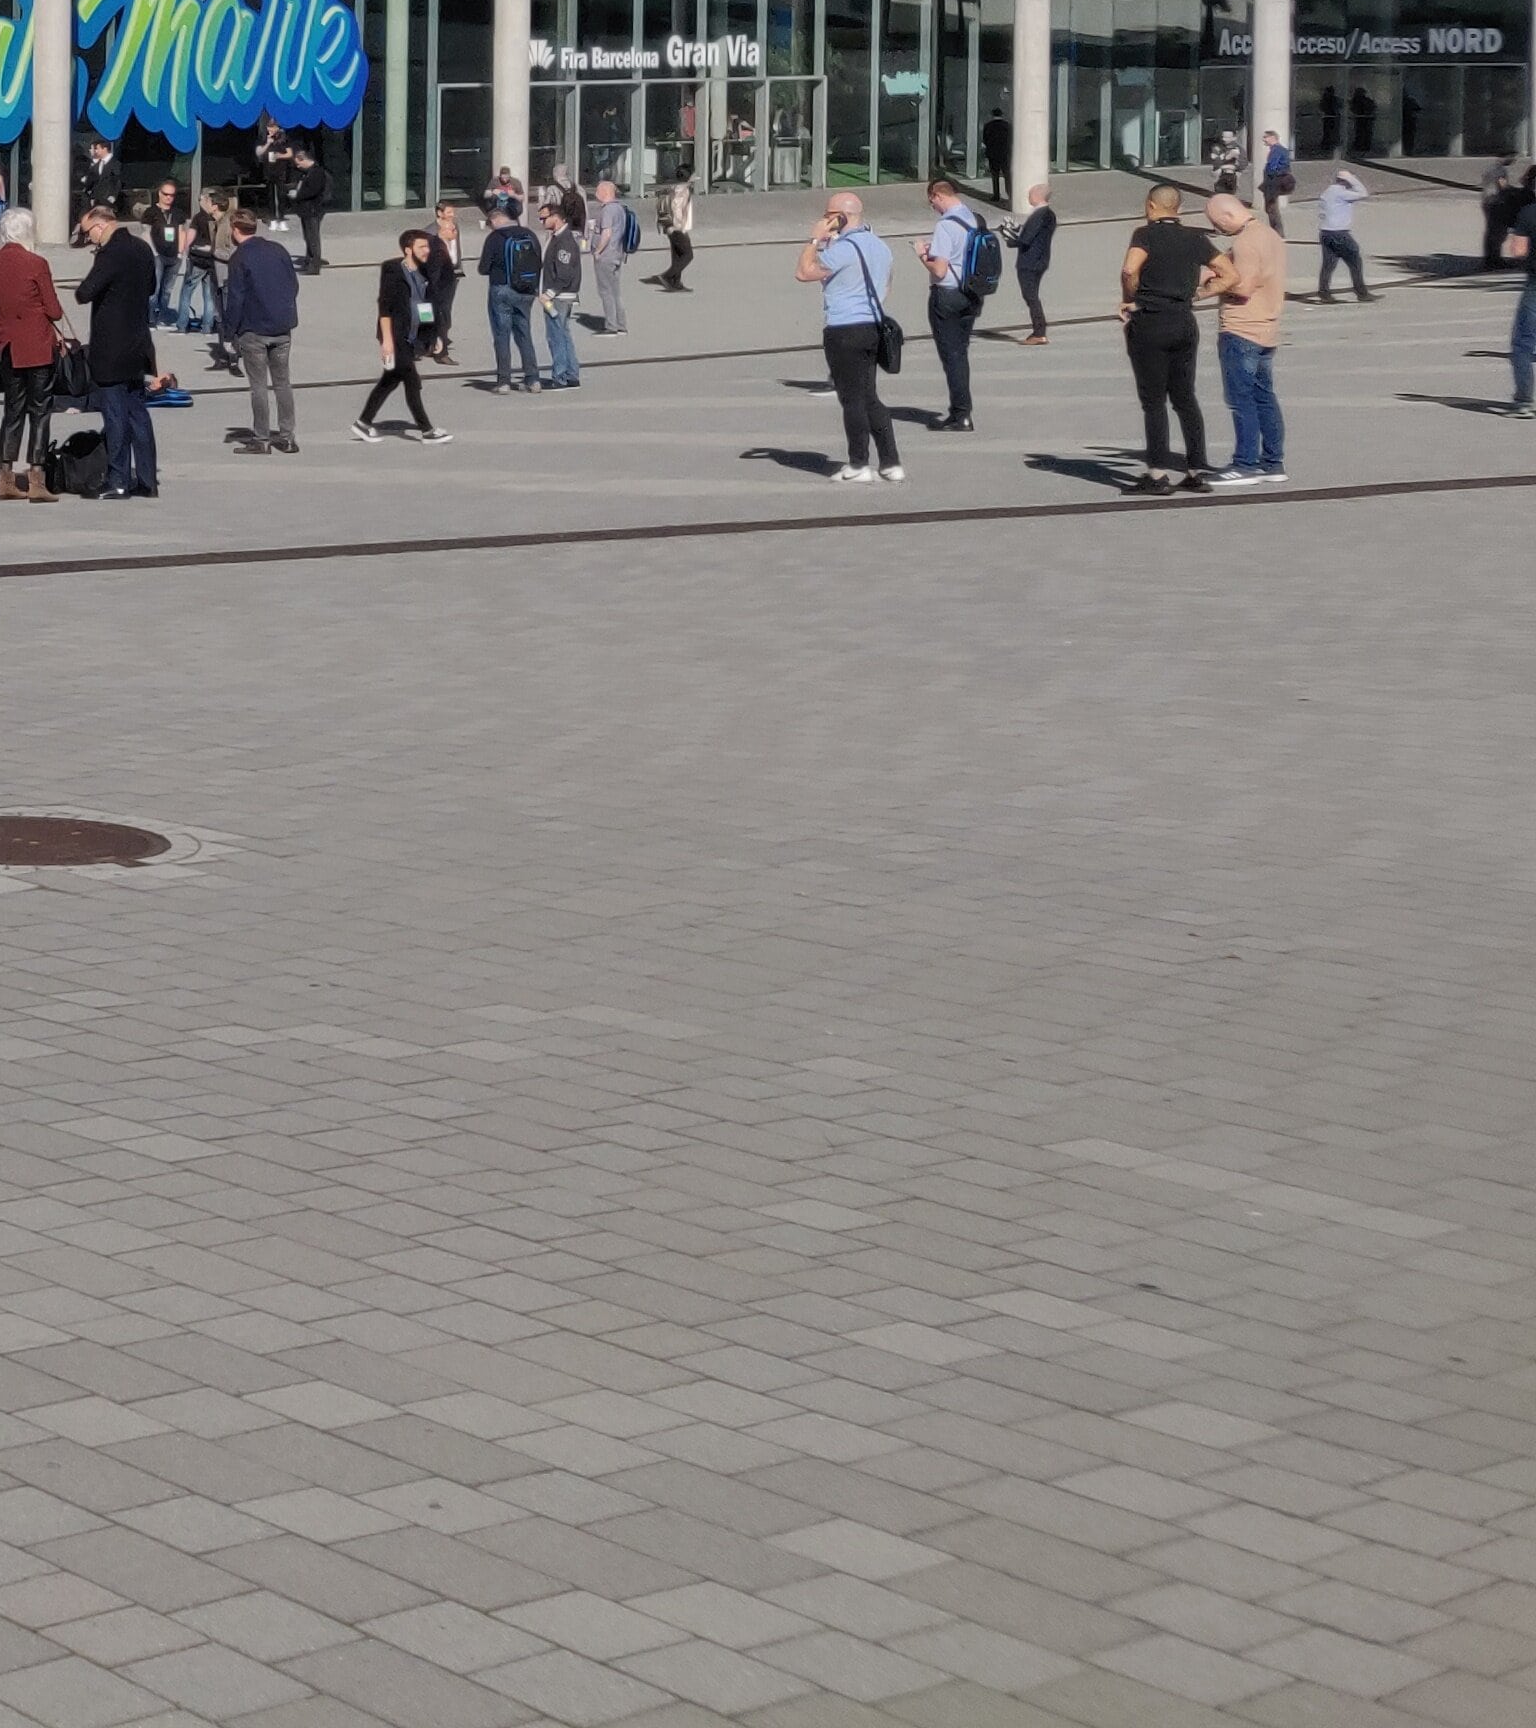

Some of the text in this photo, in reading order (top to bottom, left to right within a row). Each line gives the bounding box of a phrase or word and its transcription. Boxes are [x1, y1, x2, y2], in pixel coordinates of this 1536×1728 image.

[560, 34, 760, 70] Fira Barcelona Gran Via
[1428, 27, 1503, 54] NORD
